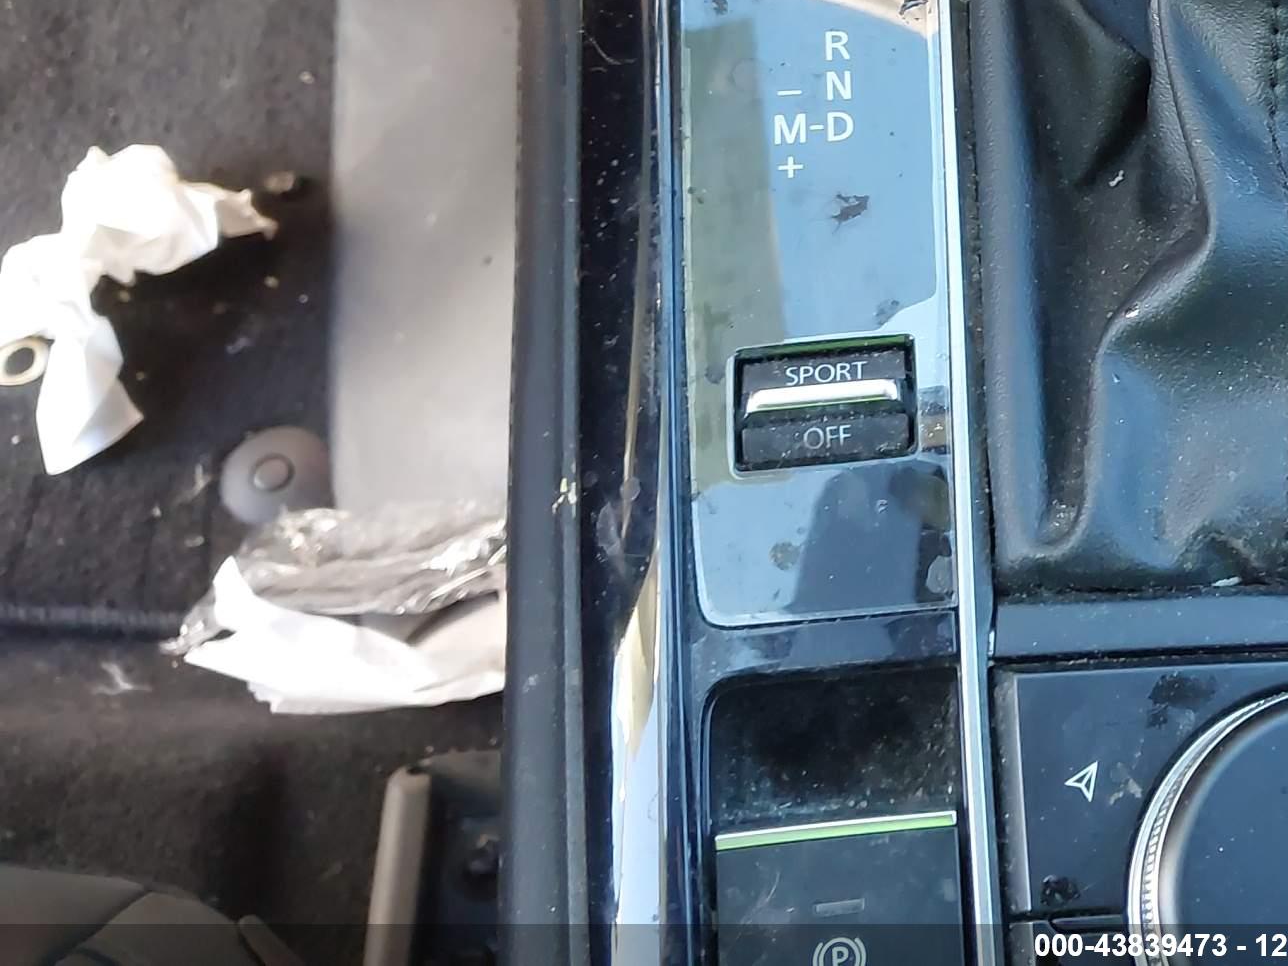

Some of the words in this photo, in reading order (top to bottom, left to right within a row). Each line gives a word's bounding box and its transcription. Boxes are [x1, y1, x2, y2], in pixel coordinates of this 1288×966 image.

[825, 31, 849, 60] R
[827, 70, 852, 100] N
[785, 361, 868, 386] SPORT
[803, 425, 852, 449] OFF
